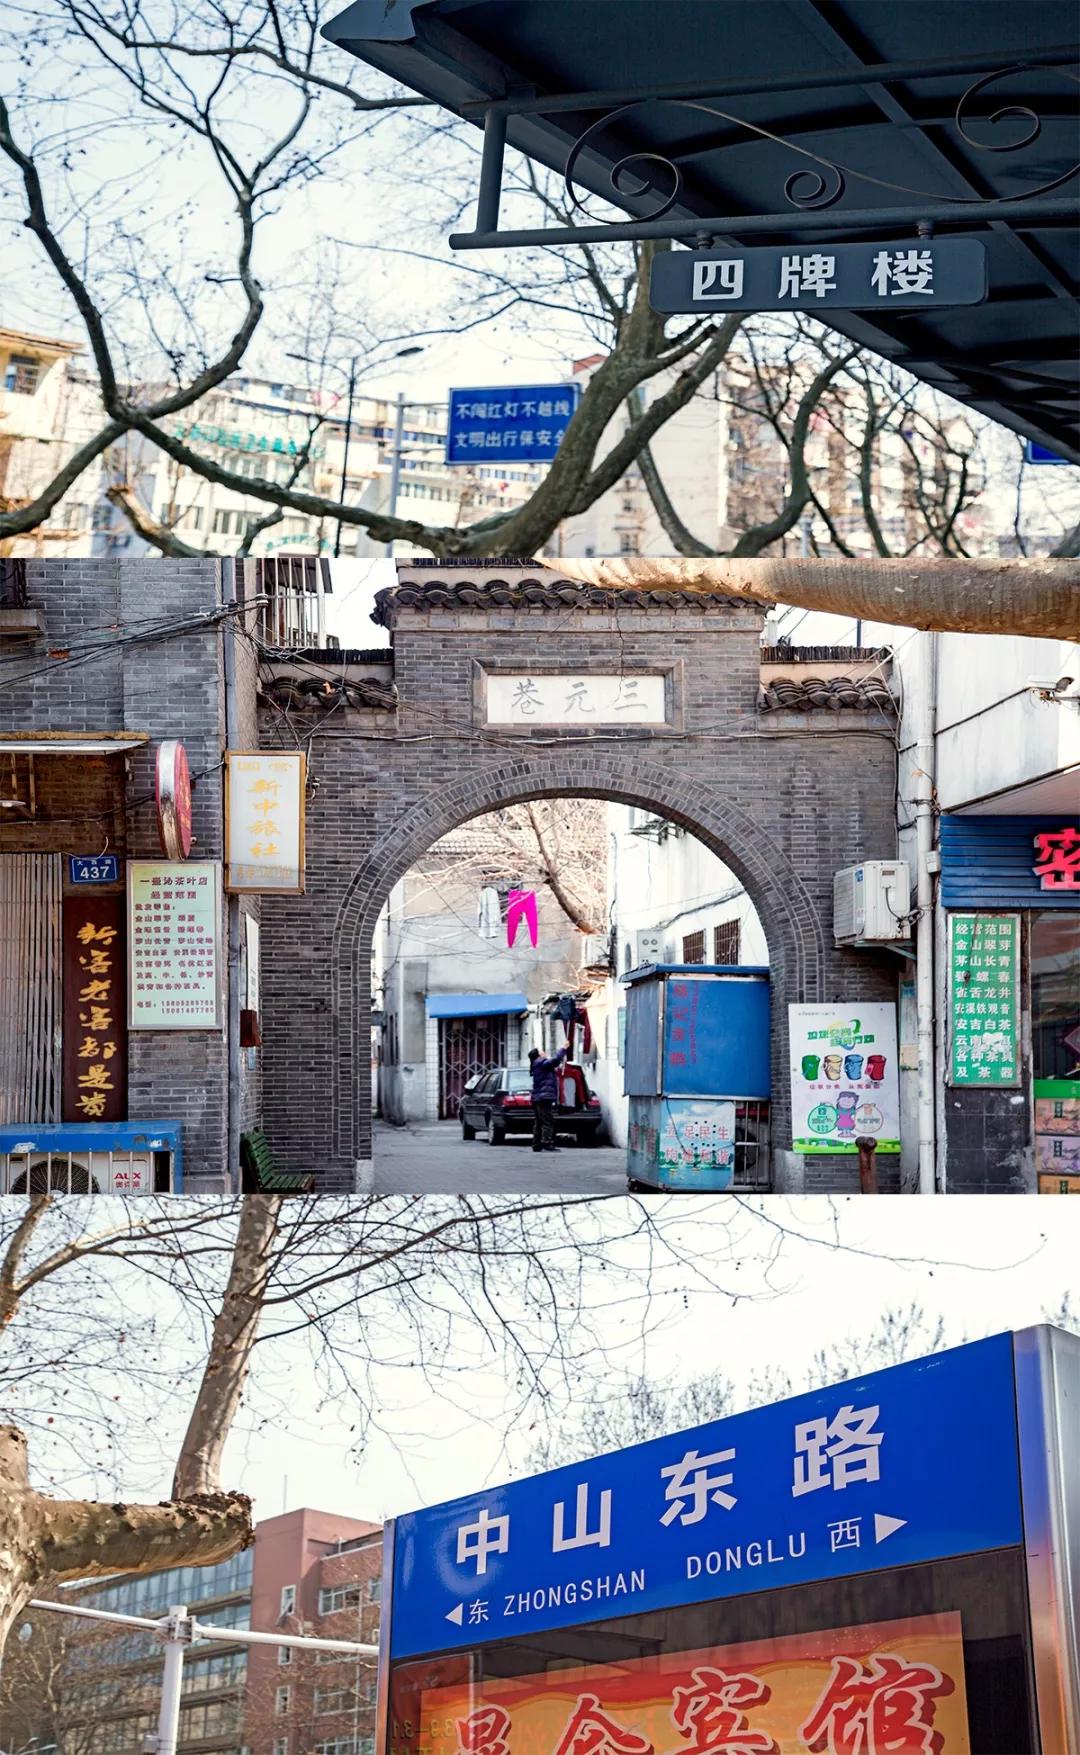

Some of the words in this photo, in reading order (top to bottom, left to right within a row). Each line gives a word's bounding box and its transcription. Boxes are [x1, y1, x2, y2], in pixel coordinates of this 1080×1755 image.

[692, 249, 935, 302] 四牌楼
[512, 678, 649, 715] 三元巷
[80, 866, 110, 879] 437
[955, 923, 1012, 936] 经营范围
[75, 921, 118, 1122] 新客老客都是贵
[955, 1018, 1012, 1031] 安吉白茶
[455, 1404, 885, 1576] 中山东路
[467, 1599, 490, 1626] 东
[503, 1568, 647, 1617] ZHONGSHAN
[686, 1533, 808, 1580] DONGLU
[828, 1517, 861, 1553] 西
